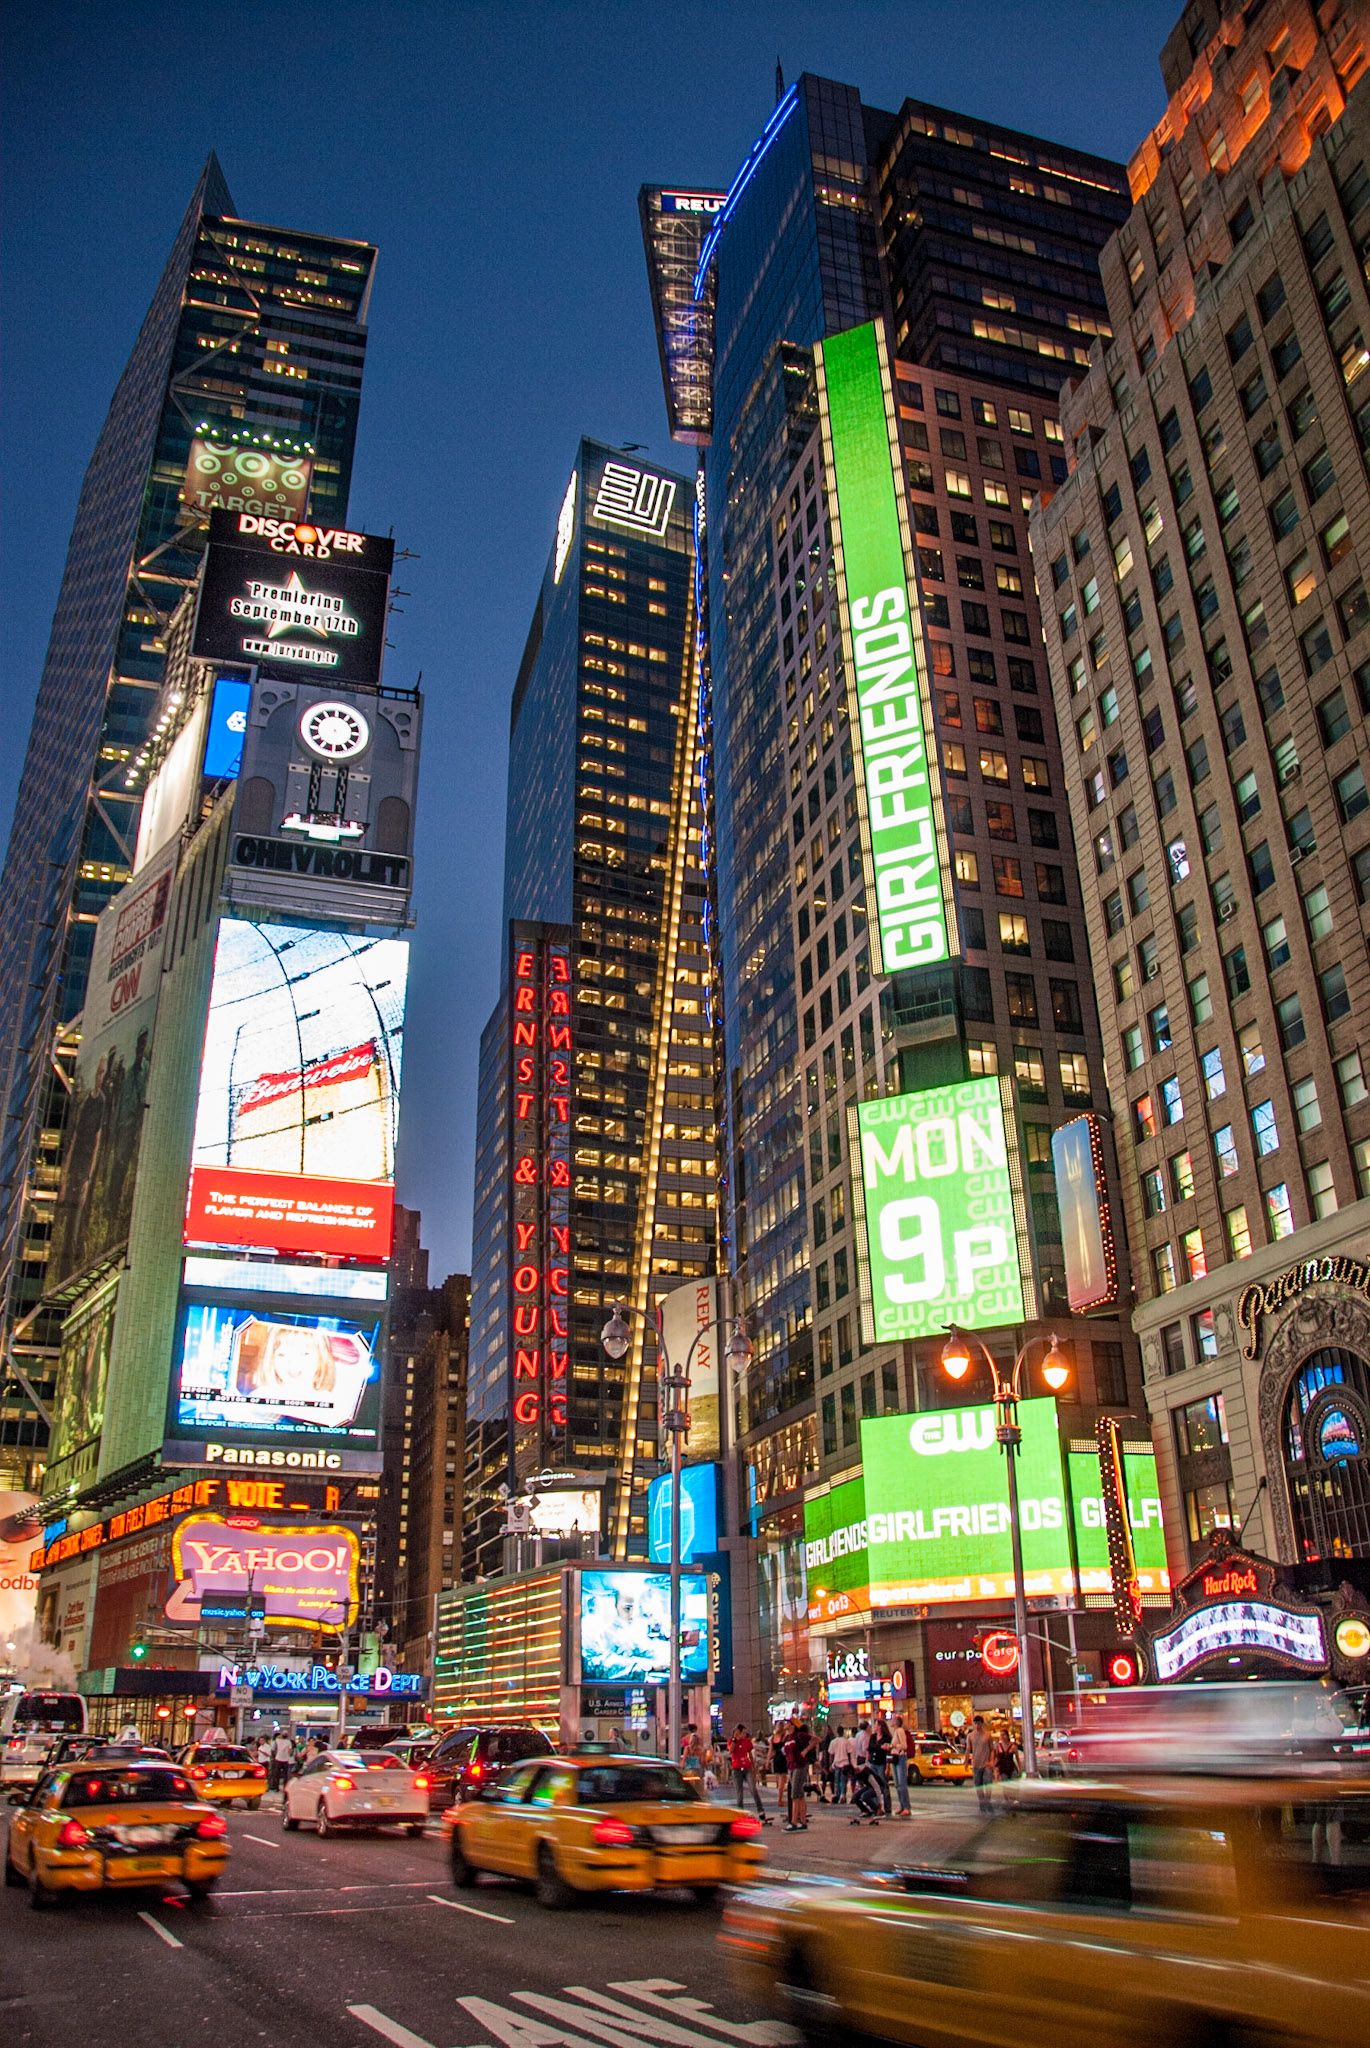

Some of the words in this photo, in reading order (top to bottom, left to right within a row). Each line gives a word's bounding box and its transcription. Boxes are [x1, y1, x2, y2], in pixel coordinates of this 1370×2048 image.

[196, 490, 296, 522] TARGET
[238, 513, 364, 554] DISCOVER
[270, 536, 331, 559] CARD
[252, 583, 343, 612] Premiering
[231, 598, 320, 628] September
[325, 616, 358, 634] 17th
[851, 586, 945, 970] GIRLFRIENDS
[514, 953, 537, 1119] ERNST
[861, 1106, 1008, 1190] MON
[513, 1156, 538, 1184] &
[204, 1204, 254, 1219] FLAVOR
[255, 1209, 285, 1221] AND
[286, 1211, 377, 1229] REFRESHMENT
[209, 1191, 237, 1205] THE
[239, 1195, 295, 1209] PERFECT
[297, 1200, 355, 1216] BALANCE
[356, 1206, 374, 1217] OF
[514, 1223, 540, 1424] YOUNG
[696, 1285, 711, 1370] REPAY
[275, 1424, 294, 1432] SOME
[320, 1426, 348, 1435] TROOPS
[205, 1443, 342, 1469] Panasonic
[226, 1480, 286, 1509] VOTE
[184, 1541, 348, 1575] YAHOO!
[1204, 1572, 1230, 1596] Hard
[1230, 1568, 1257, 1595] Rock
[873, 1607, 920, 1619] REUTERS
[236, 1687, 248, 1695] NO
[261, 1664, 309, 1690] YORK
[374, 1666, 421, 1692] DEPT
